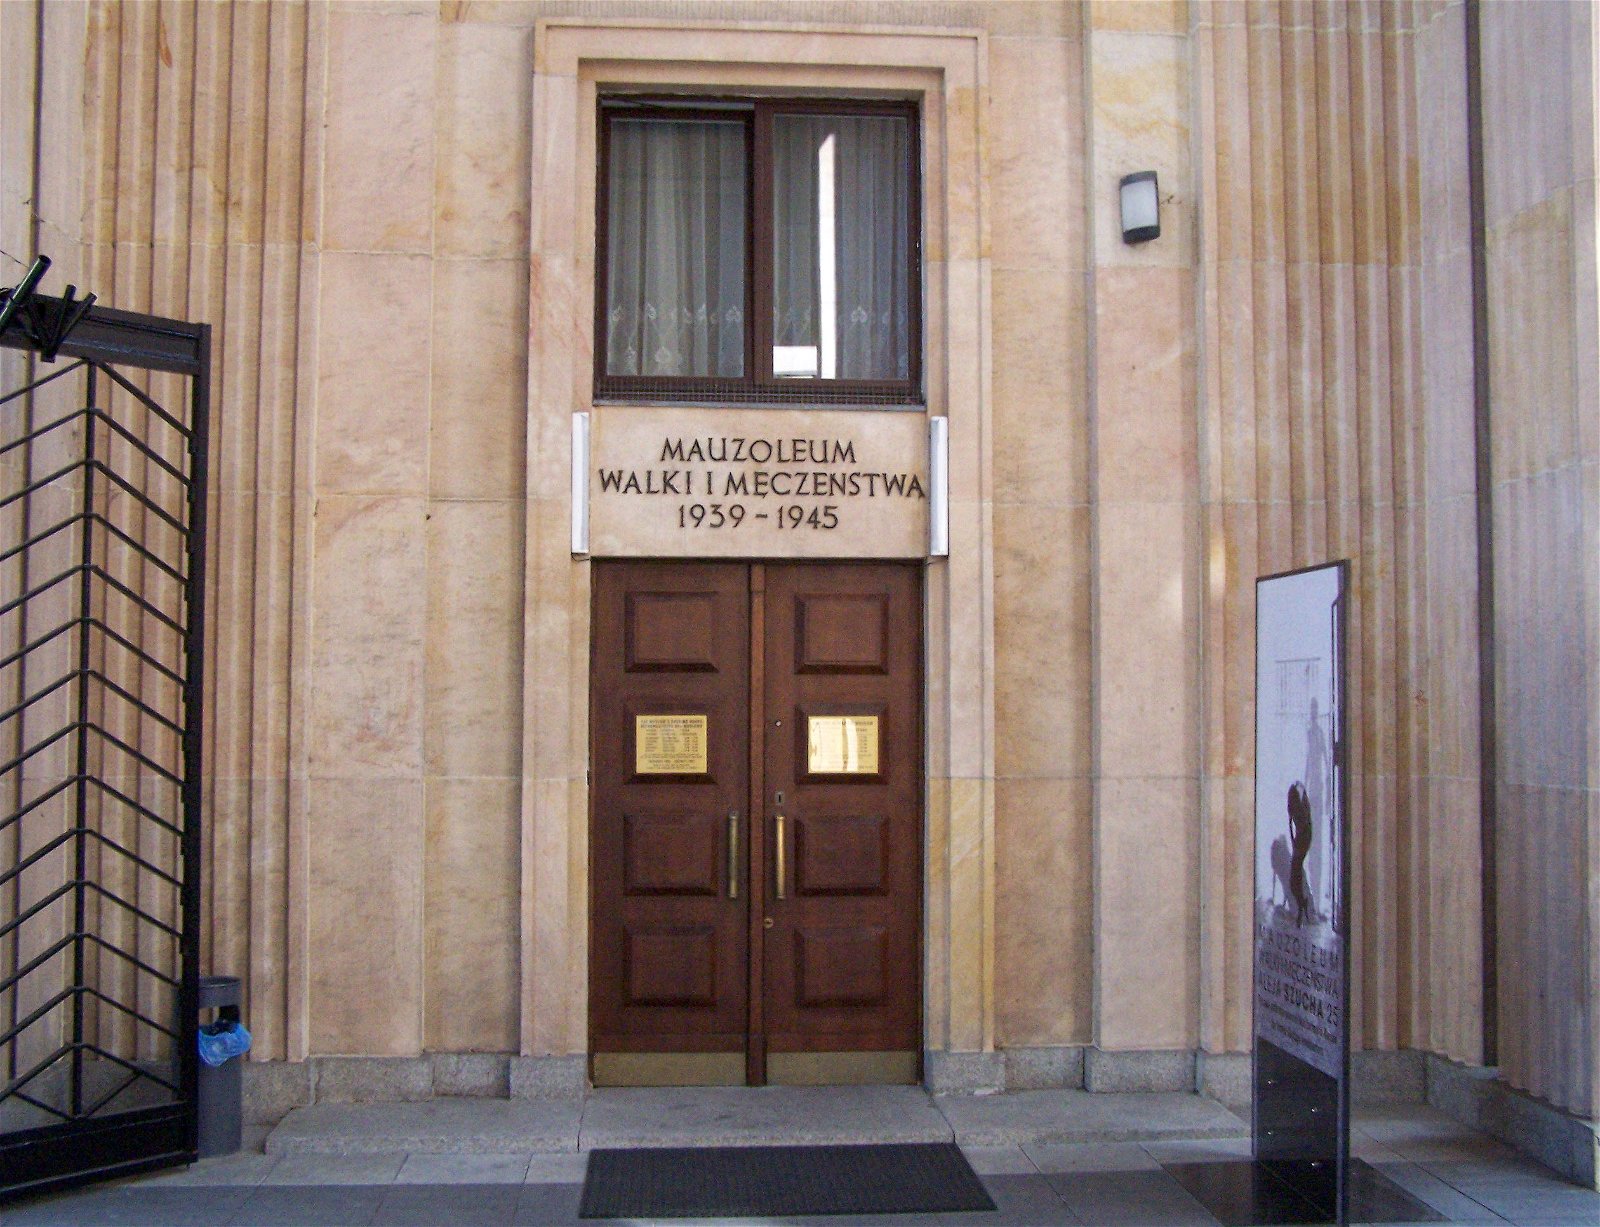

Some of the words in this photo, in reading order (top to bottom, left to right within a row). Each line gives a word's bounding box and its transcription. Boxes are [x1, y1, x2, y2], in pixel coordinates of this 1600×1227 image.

[659, 437, 857, 463] MAUZOLEUM
[597, 469, 692, 496] WALKI
[706, 471, 714, 496] I
[678, 503, 747, 529] 1939
[777, 504, 839, 529] 1945
[1283, 981, 1323, 1019] SZUCHA
